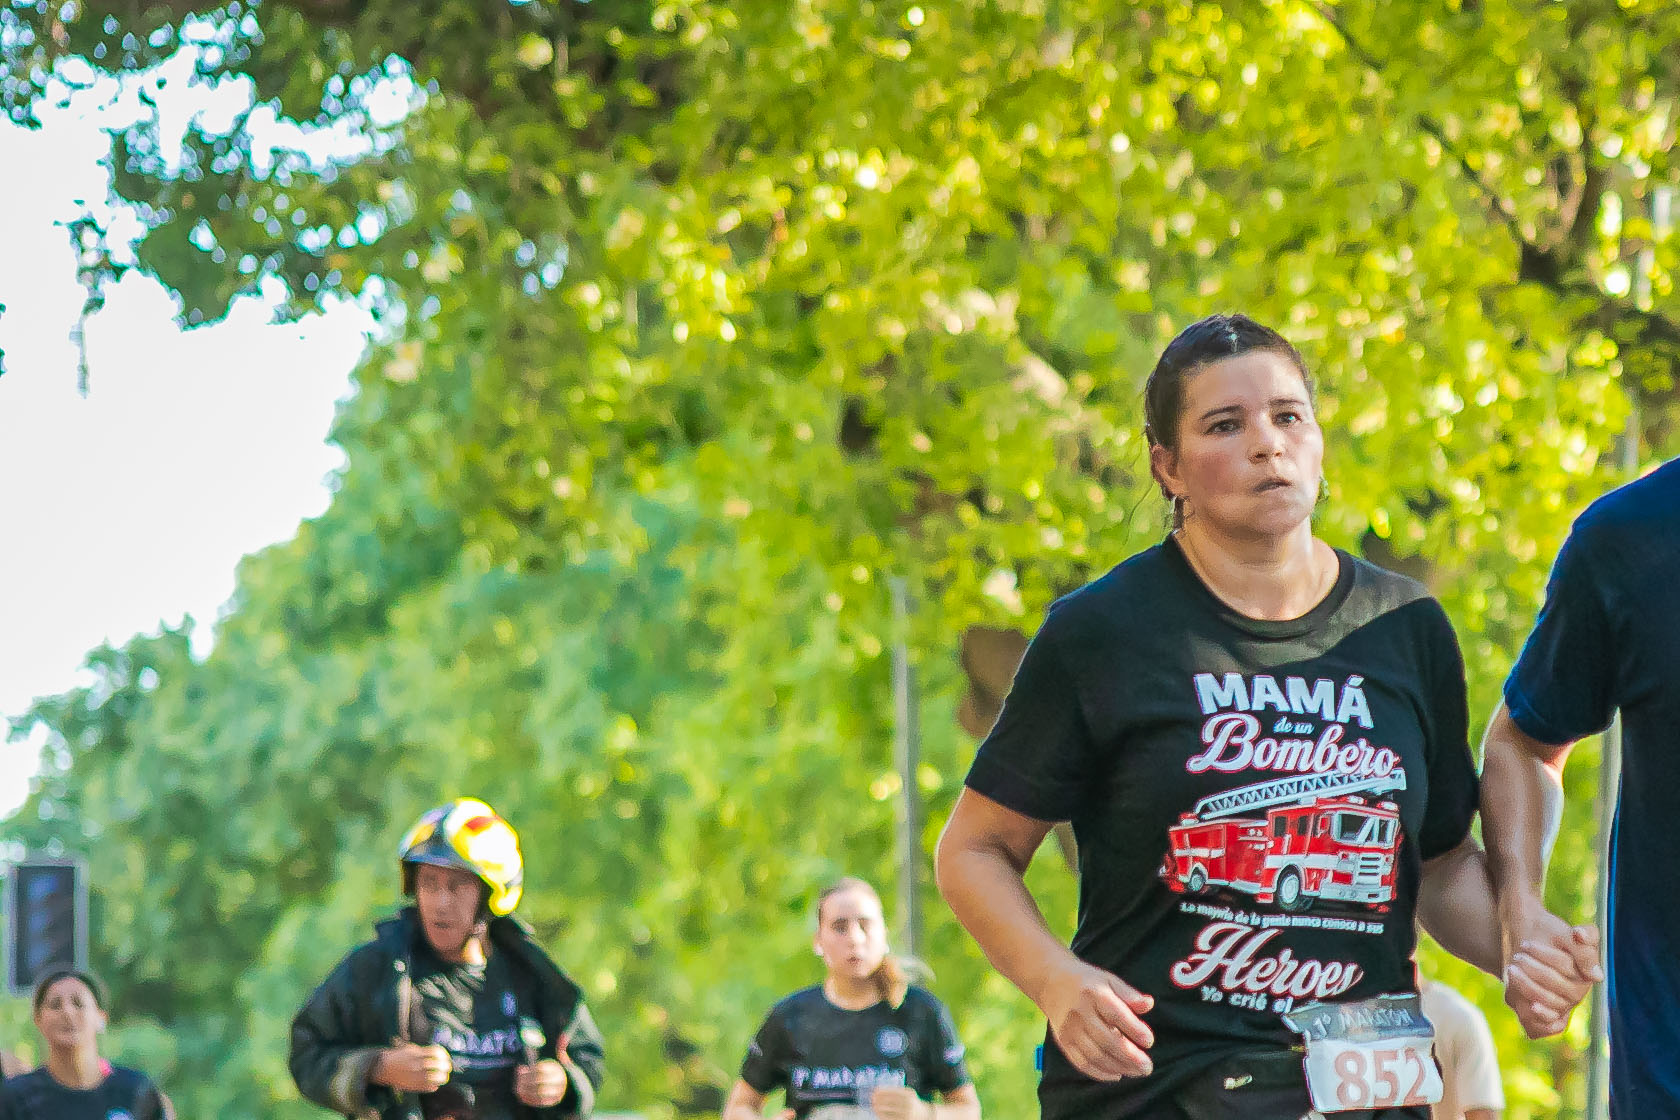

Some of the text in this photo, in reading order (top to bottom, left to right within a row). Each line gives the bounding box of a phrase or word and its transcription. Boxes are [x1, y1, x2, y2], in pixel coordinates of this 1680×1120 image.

[1193, 672, 1374, 729] MAMÁ
[1273, 716, 1315, 735] de un
[1186, 712, 1401, 778] Bombero
[1321, 918, 1358, 931] conoce
[1169, 921, 1364, 999] Heroes
[1200, 986, 1223, 1003] Yo
[1335, 1047, 1428, 1108] 852
